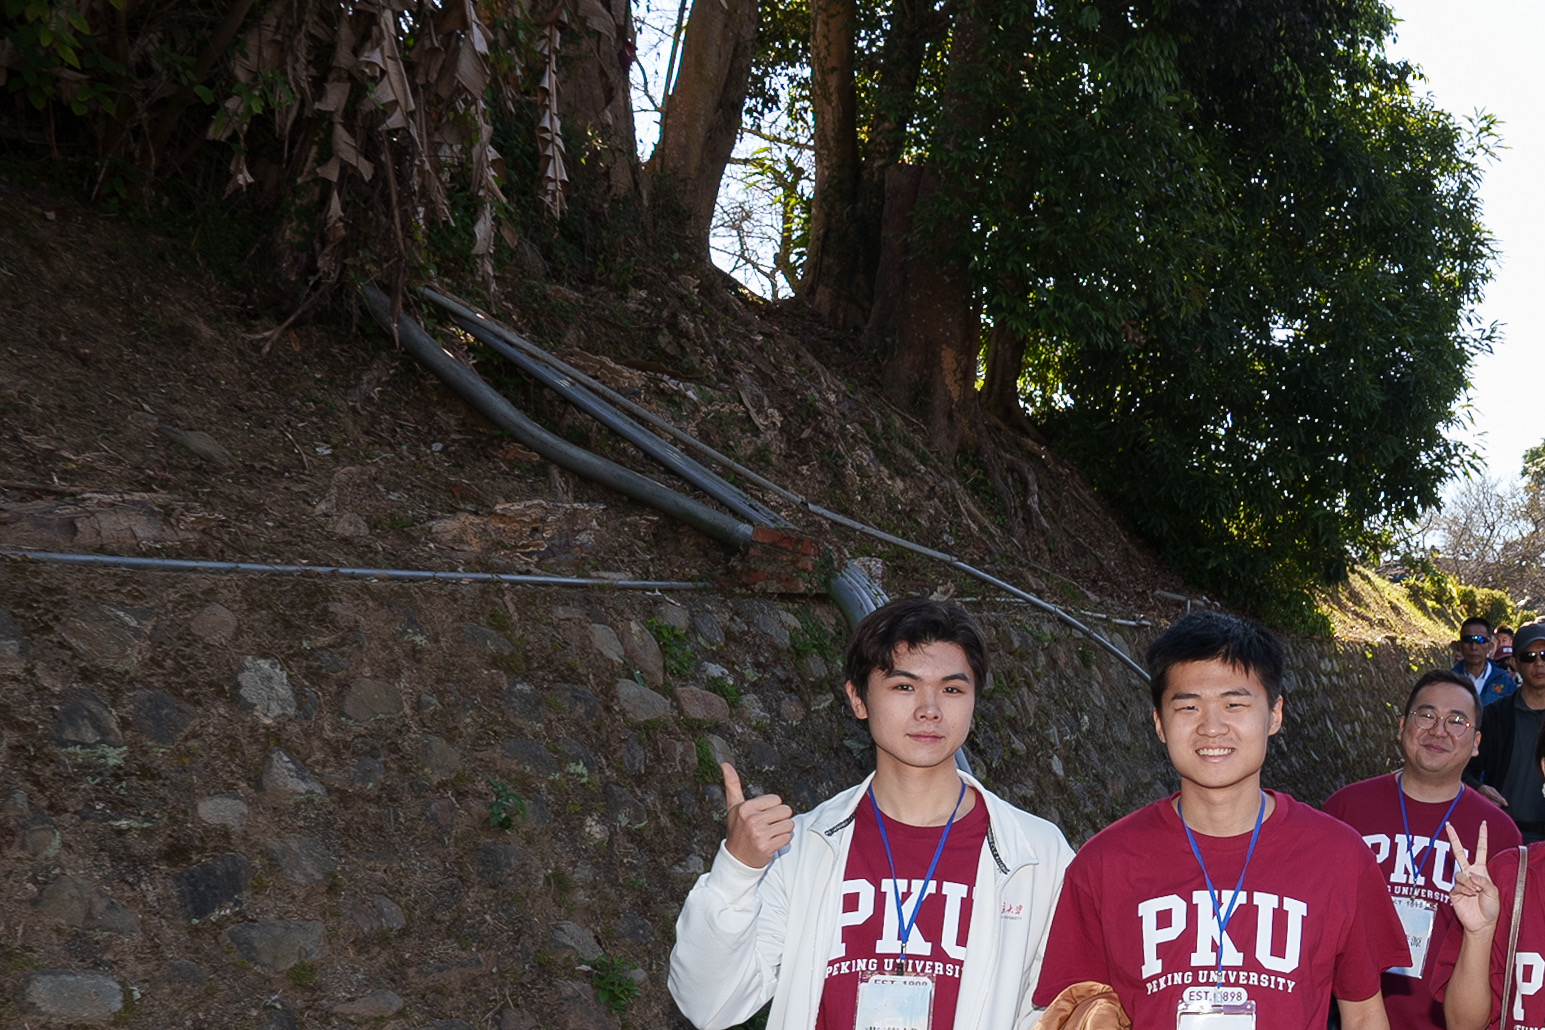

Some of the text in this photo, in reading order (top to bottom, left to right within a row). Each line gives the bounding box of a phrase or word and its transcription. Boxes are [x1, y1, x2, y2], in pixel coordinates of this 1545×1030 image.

[1394, 885, 1453, 906] UNIVERSIT
[1138, 889, 1308, 979] PKU
[825, 958, 878, 979] PEKING
[1146, 970, 1296, 995] PEKING UNIVERSITY
[1213, 991, 1242, 1001] 898
